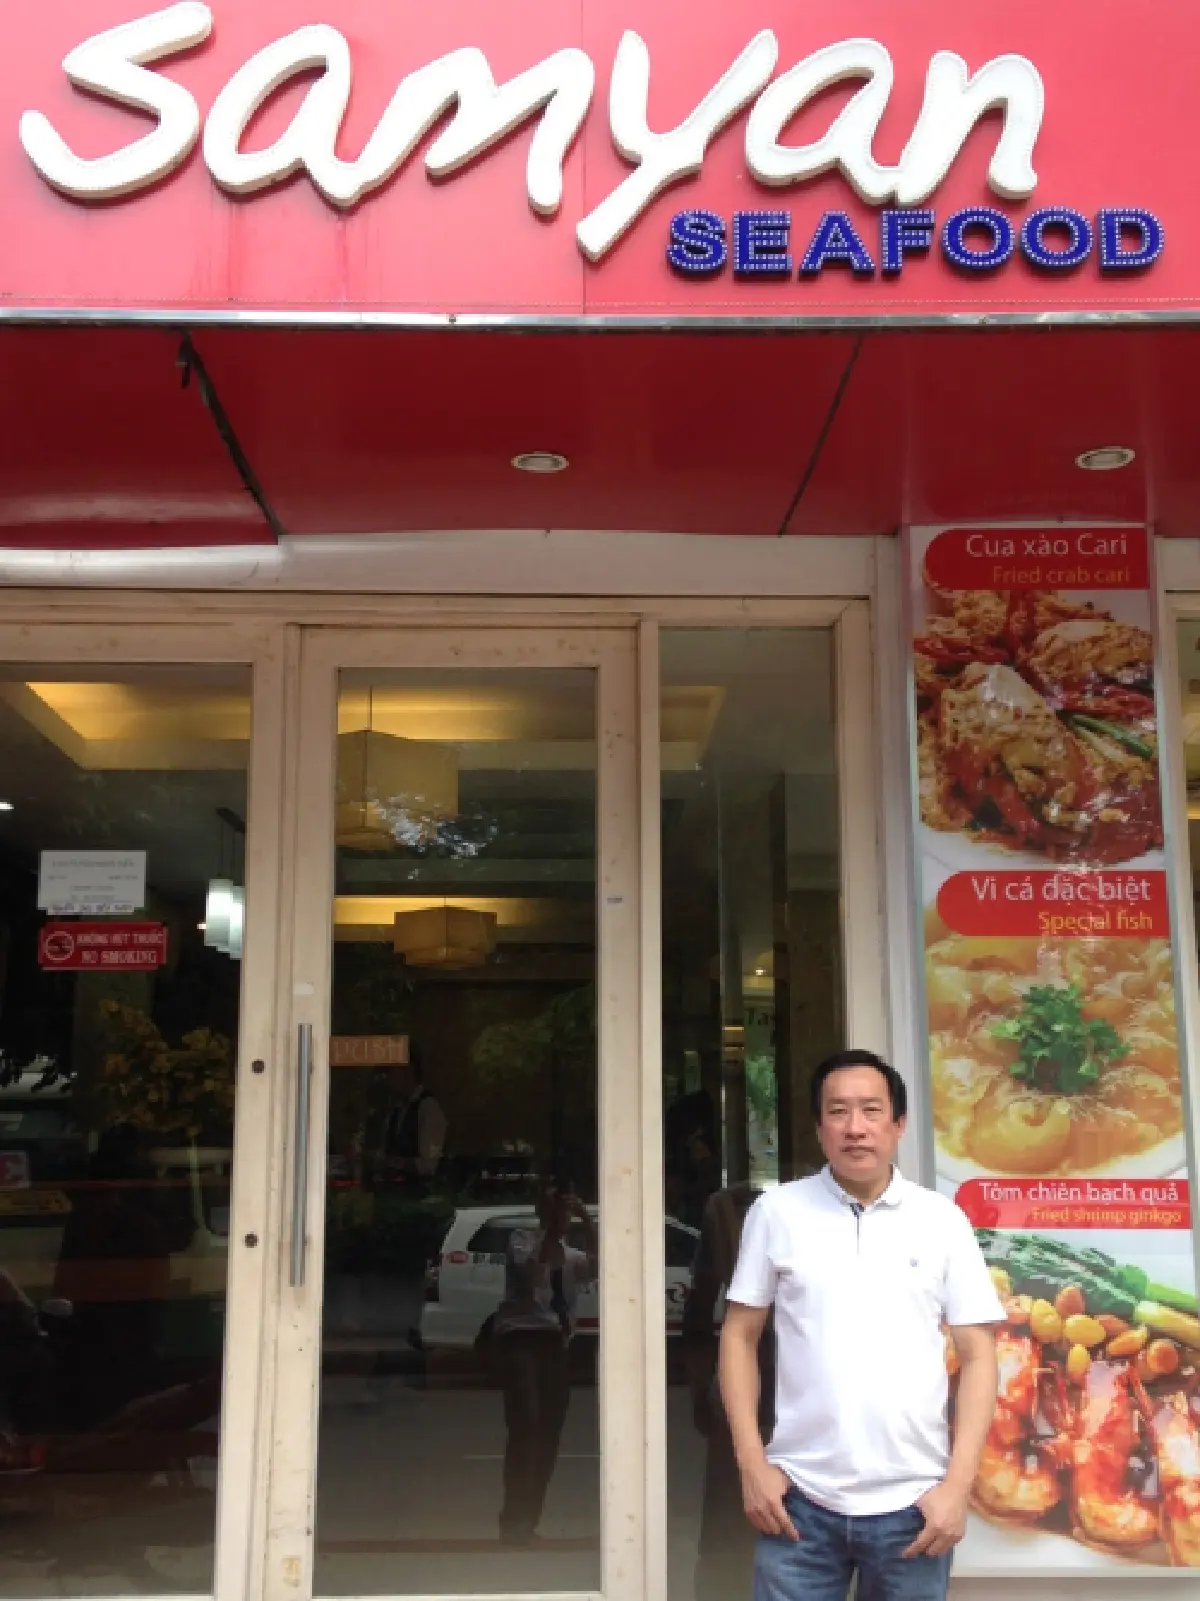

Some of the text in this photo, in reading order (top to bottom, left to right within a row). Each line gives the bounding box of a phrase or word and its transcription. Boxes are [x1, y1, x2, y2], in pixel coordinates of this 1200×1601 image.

[666, 205, 1166, 277] SEAFOOD
[966, 532, 1128, 557] Cua xào Cari
[993, 565, 1130, 583] Fried crab cari
[971, 875, 997, 901] Vi
[1005, 875, 1034, 901] cá
[1097, 875, 1151, 906] biệt
[1038, 910, 1153, 935] Special fish
[82, 950, 157, 963] NO SMOKING
[978, 1180, 1179, 1205] Tôm chiên bạch quả
[1031, 1206, 1069, 1223] Fried
